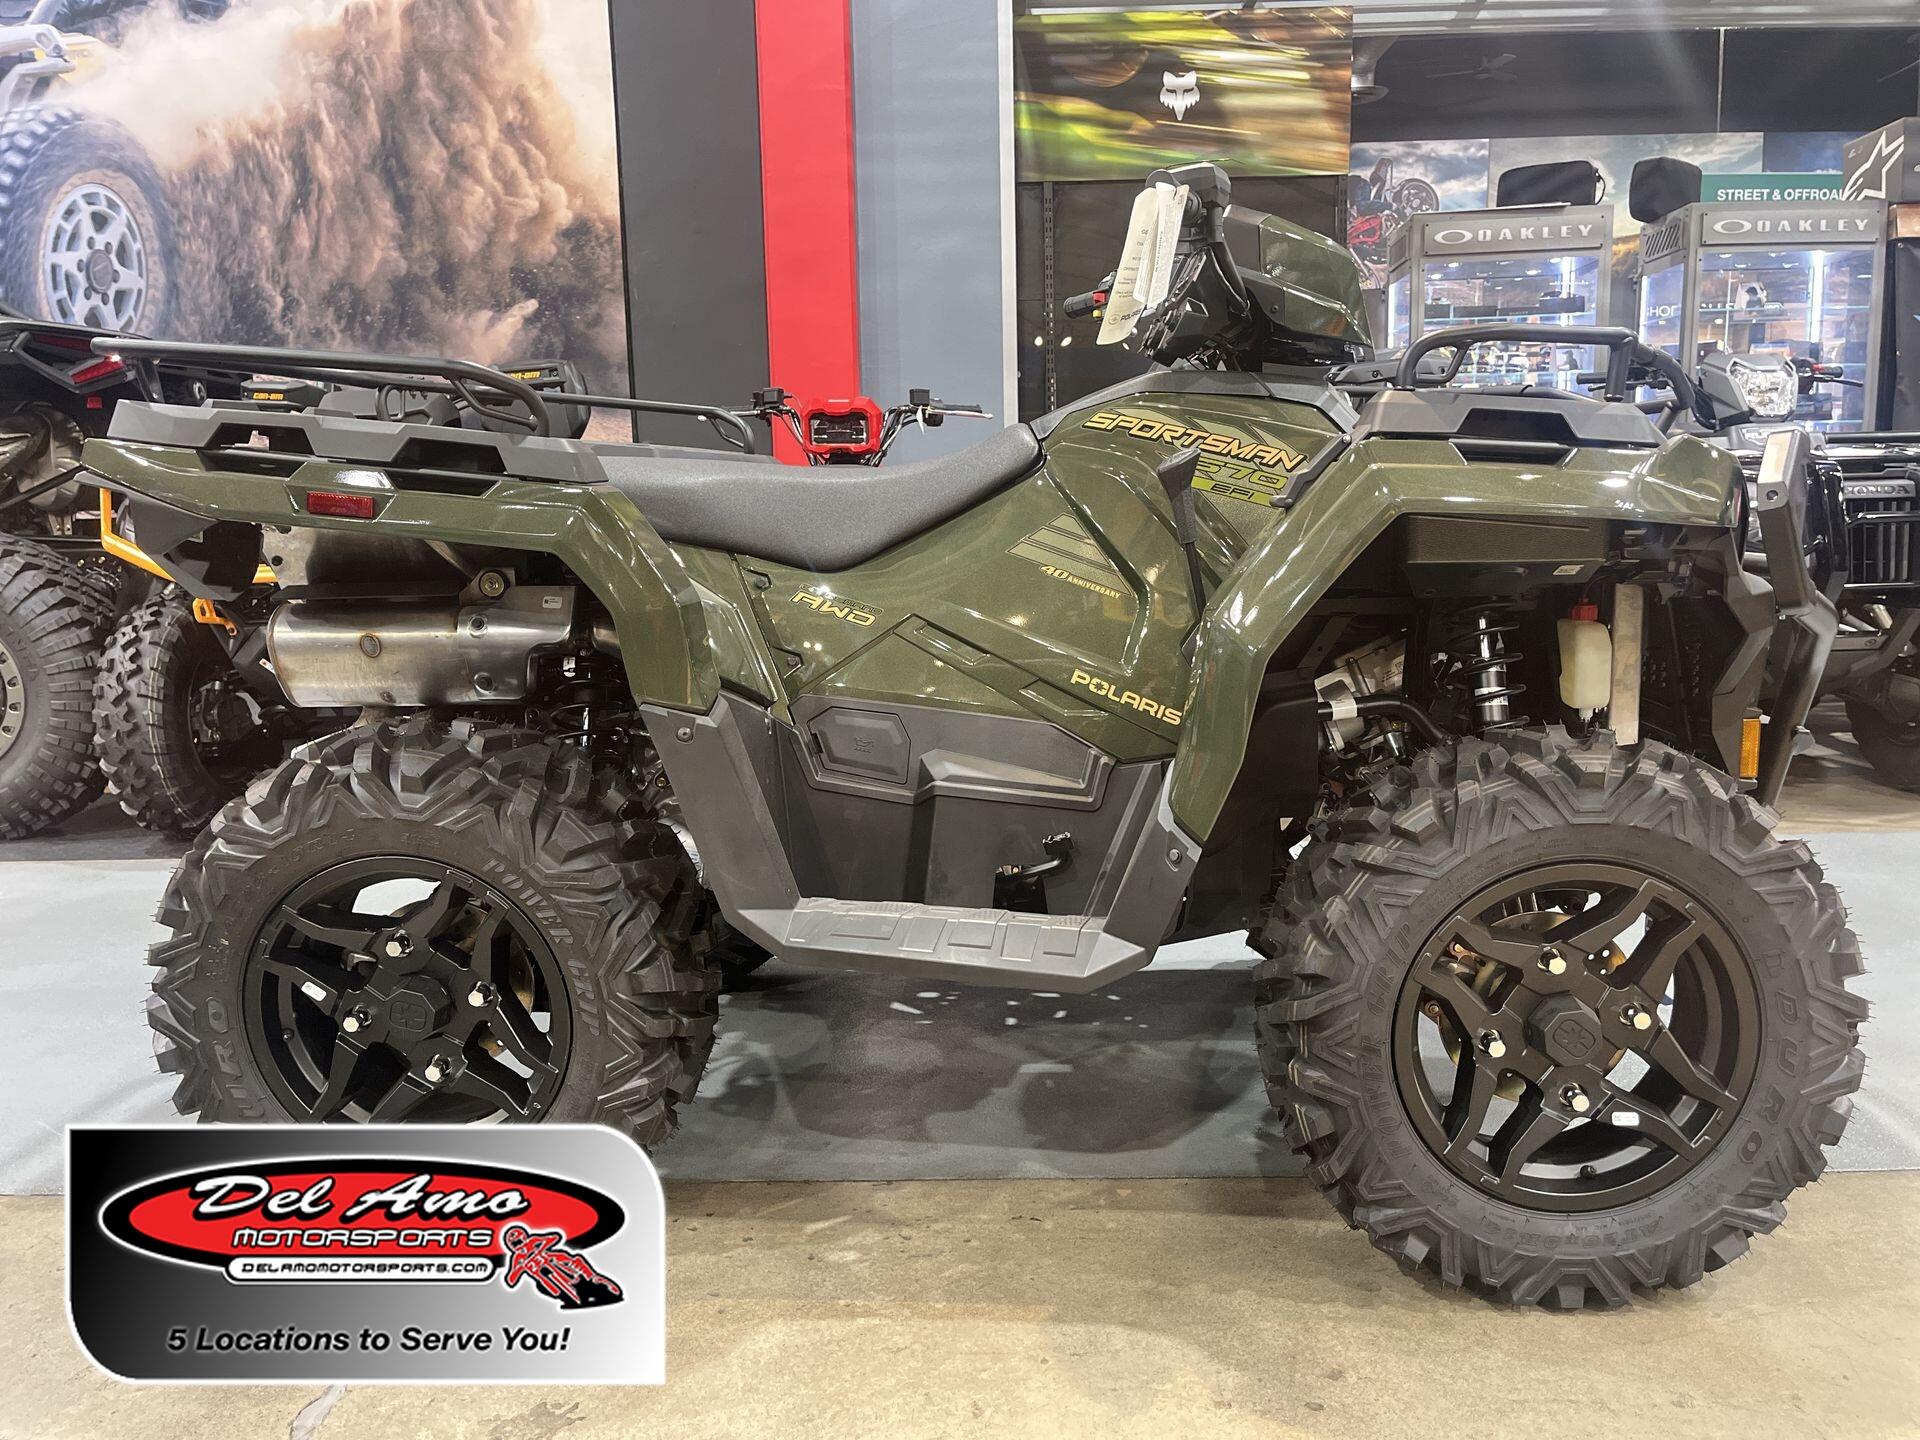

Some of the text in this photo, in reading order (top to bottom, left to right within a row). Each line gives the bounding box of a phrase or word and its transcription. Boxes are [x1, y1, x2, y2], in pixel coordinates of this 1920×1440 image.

[1717, 189, 1843, 200] STREET & OFFROA
[1478, 224, 1592, 241] OAKLEY
[1757, 219, 1868, 232] OAKLEY
[1082, 411, 1309, 472] SPORTSMAN
[1197, 456, 1289, 490] 570
[1210, 482, 1255, 500] EFI
[1040, 565, 1121, 599] 40 ANNIVERSARY
[789, 591, 877, 627] AWD
[1070, 668, 1183, 726] POLARIS
[481, 857, 601, 1036] POWER GRIP
[1737, 989, 1800, 1164] DURO
